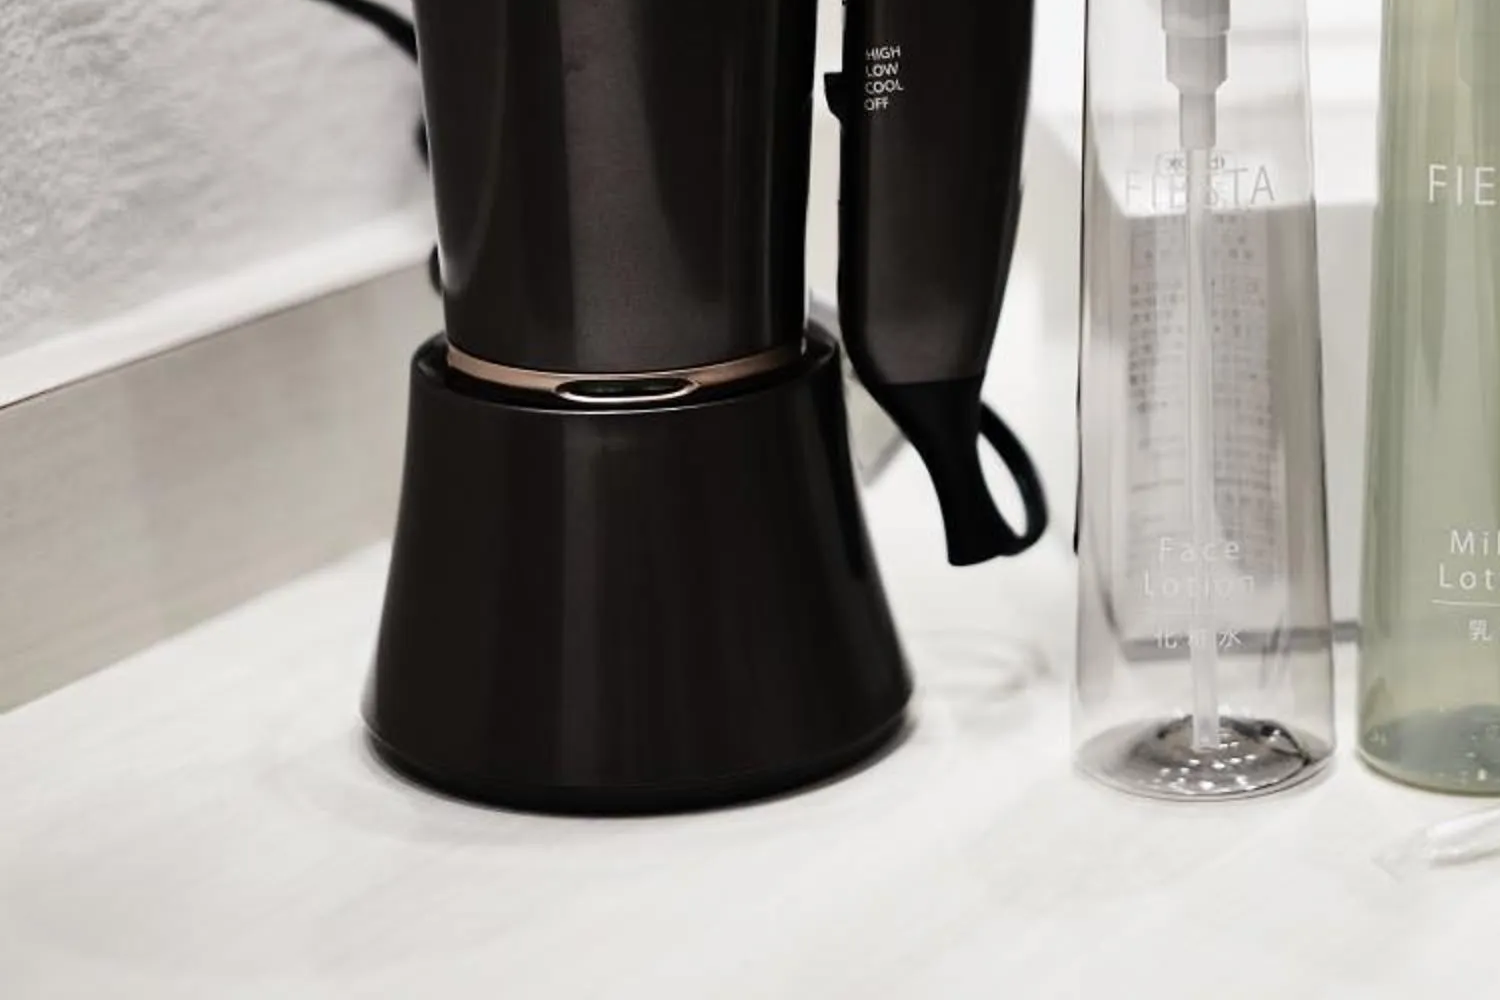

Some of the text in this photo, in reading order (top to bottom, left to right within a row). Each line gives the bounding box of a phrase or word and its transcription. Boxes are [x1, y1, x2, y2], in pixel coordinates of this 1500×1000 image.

[865, 45, 901, 60] HIGH
[865, 61, 899, 77] LOW
[864, 79, 904, 94] COOL
[864, 96, 889, 111] OFF
[1160, 537, 1240, 562] Face
